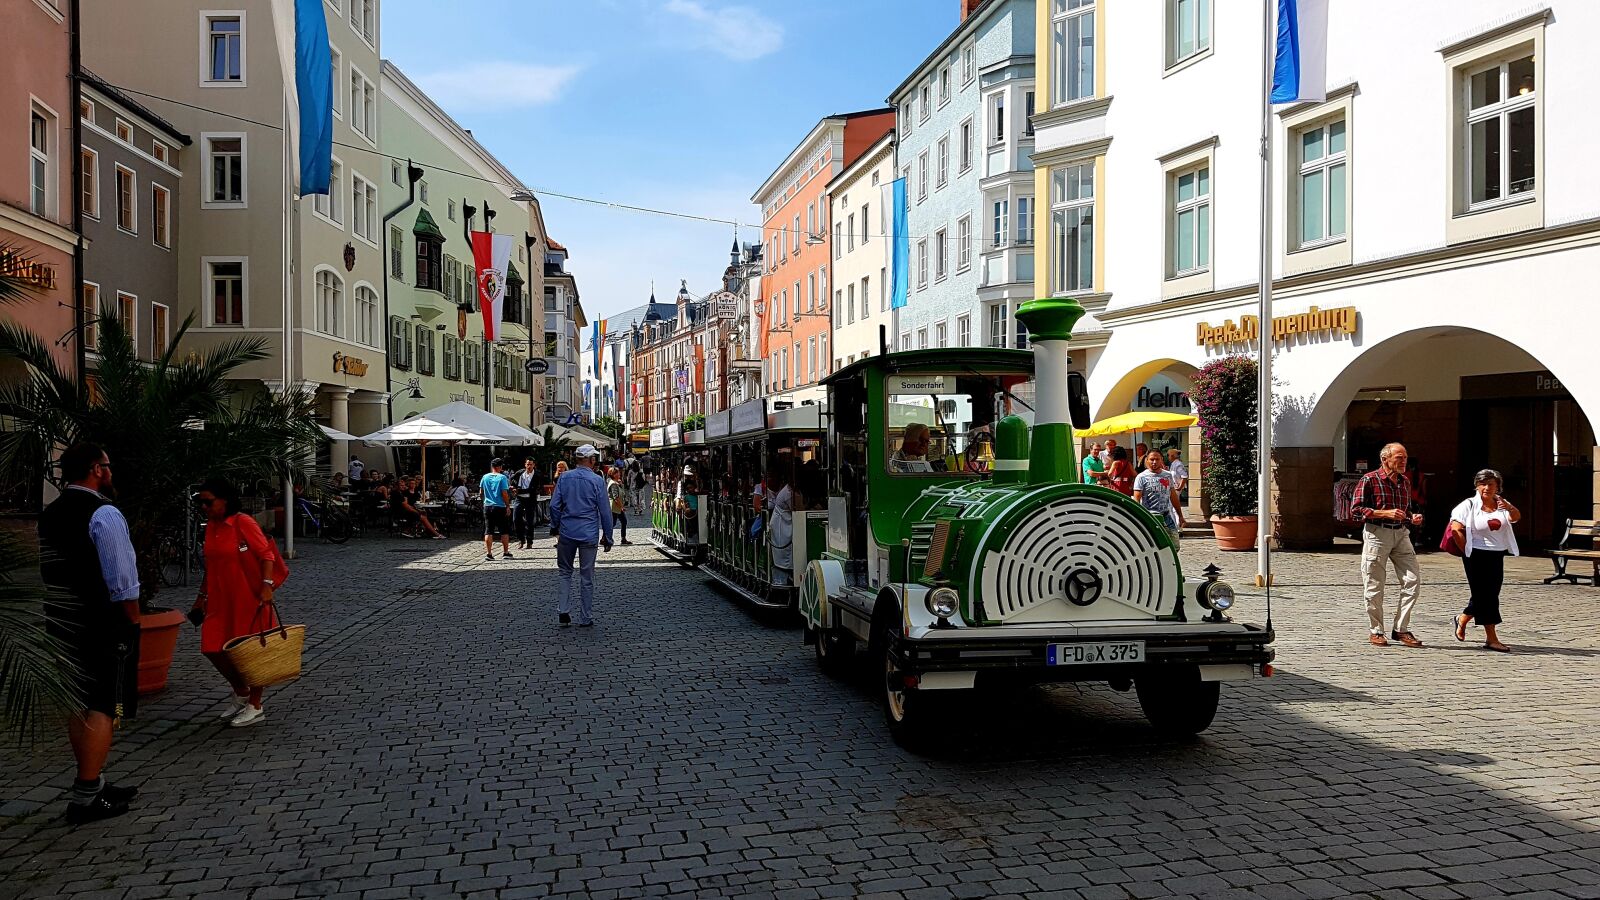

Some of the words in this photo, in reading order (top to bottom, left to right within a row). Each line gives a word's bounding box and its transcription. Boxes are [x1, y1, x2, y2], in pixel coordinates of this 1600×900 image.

[1197, 306, 1356, 346] Peek&Clpenburg
[901, 381, 945, 389] Sonderfahrt
[1536, 375, 1563, 390] Pee
[1109, 644, 1139, 661] 375
